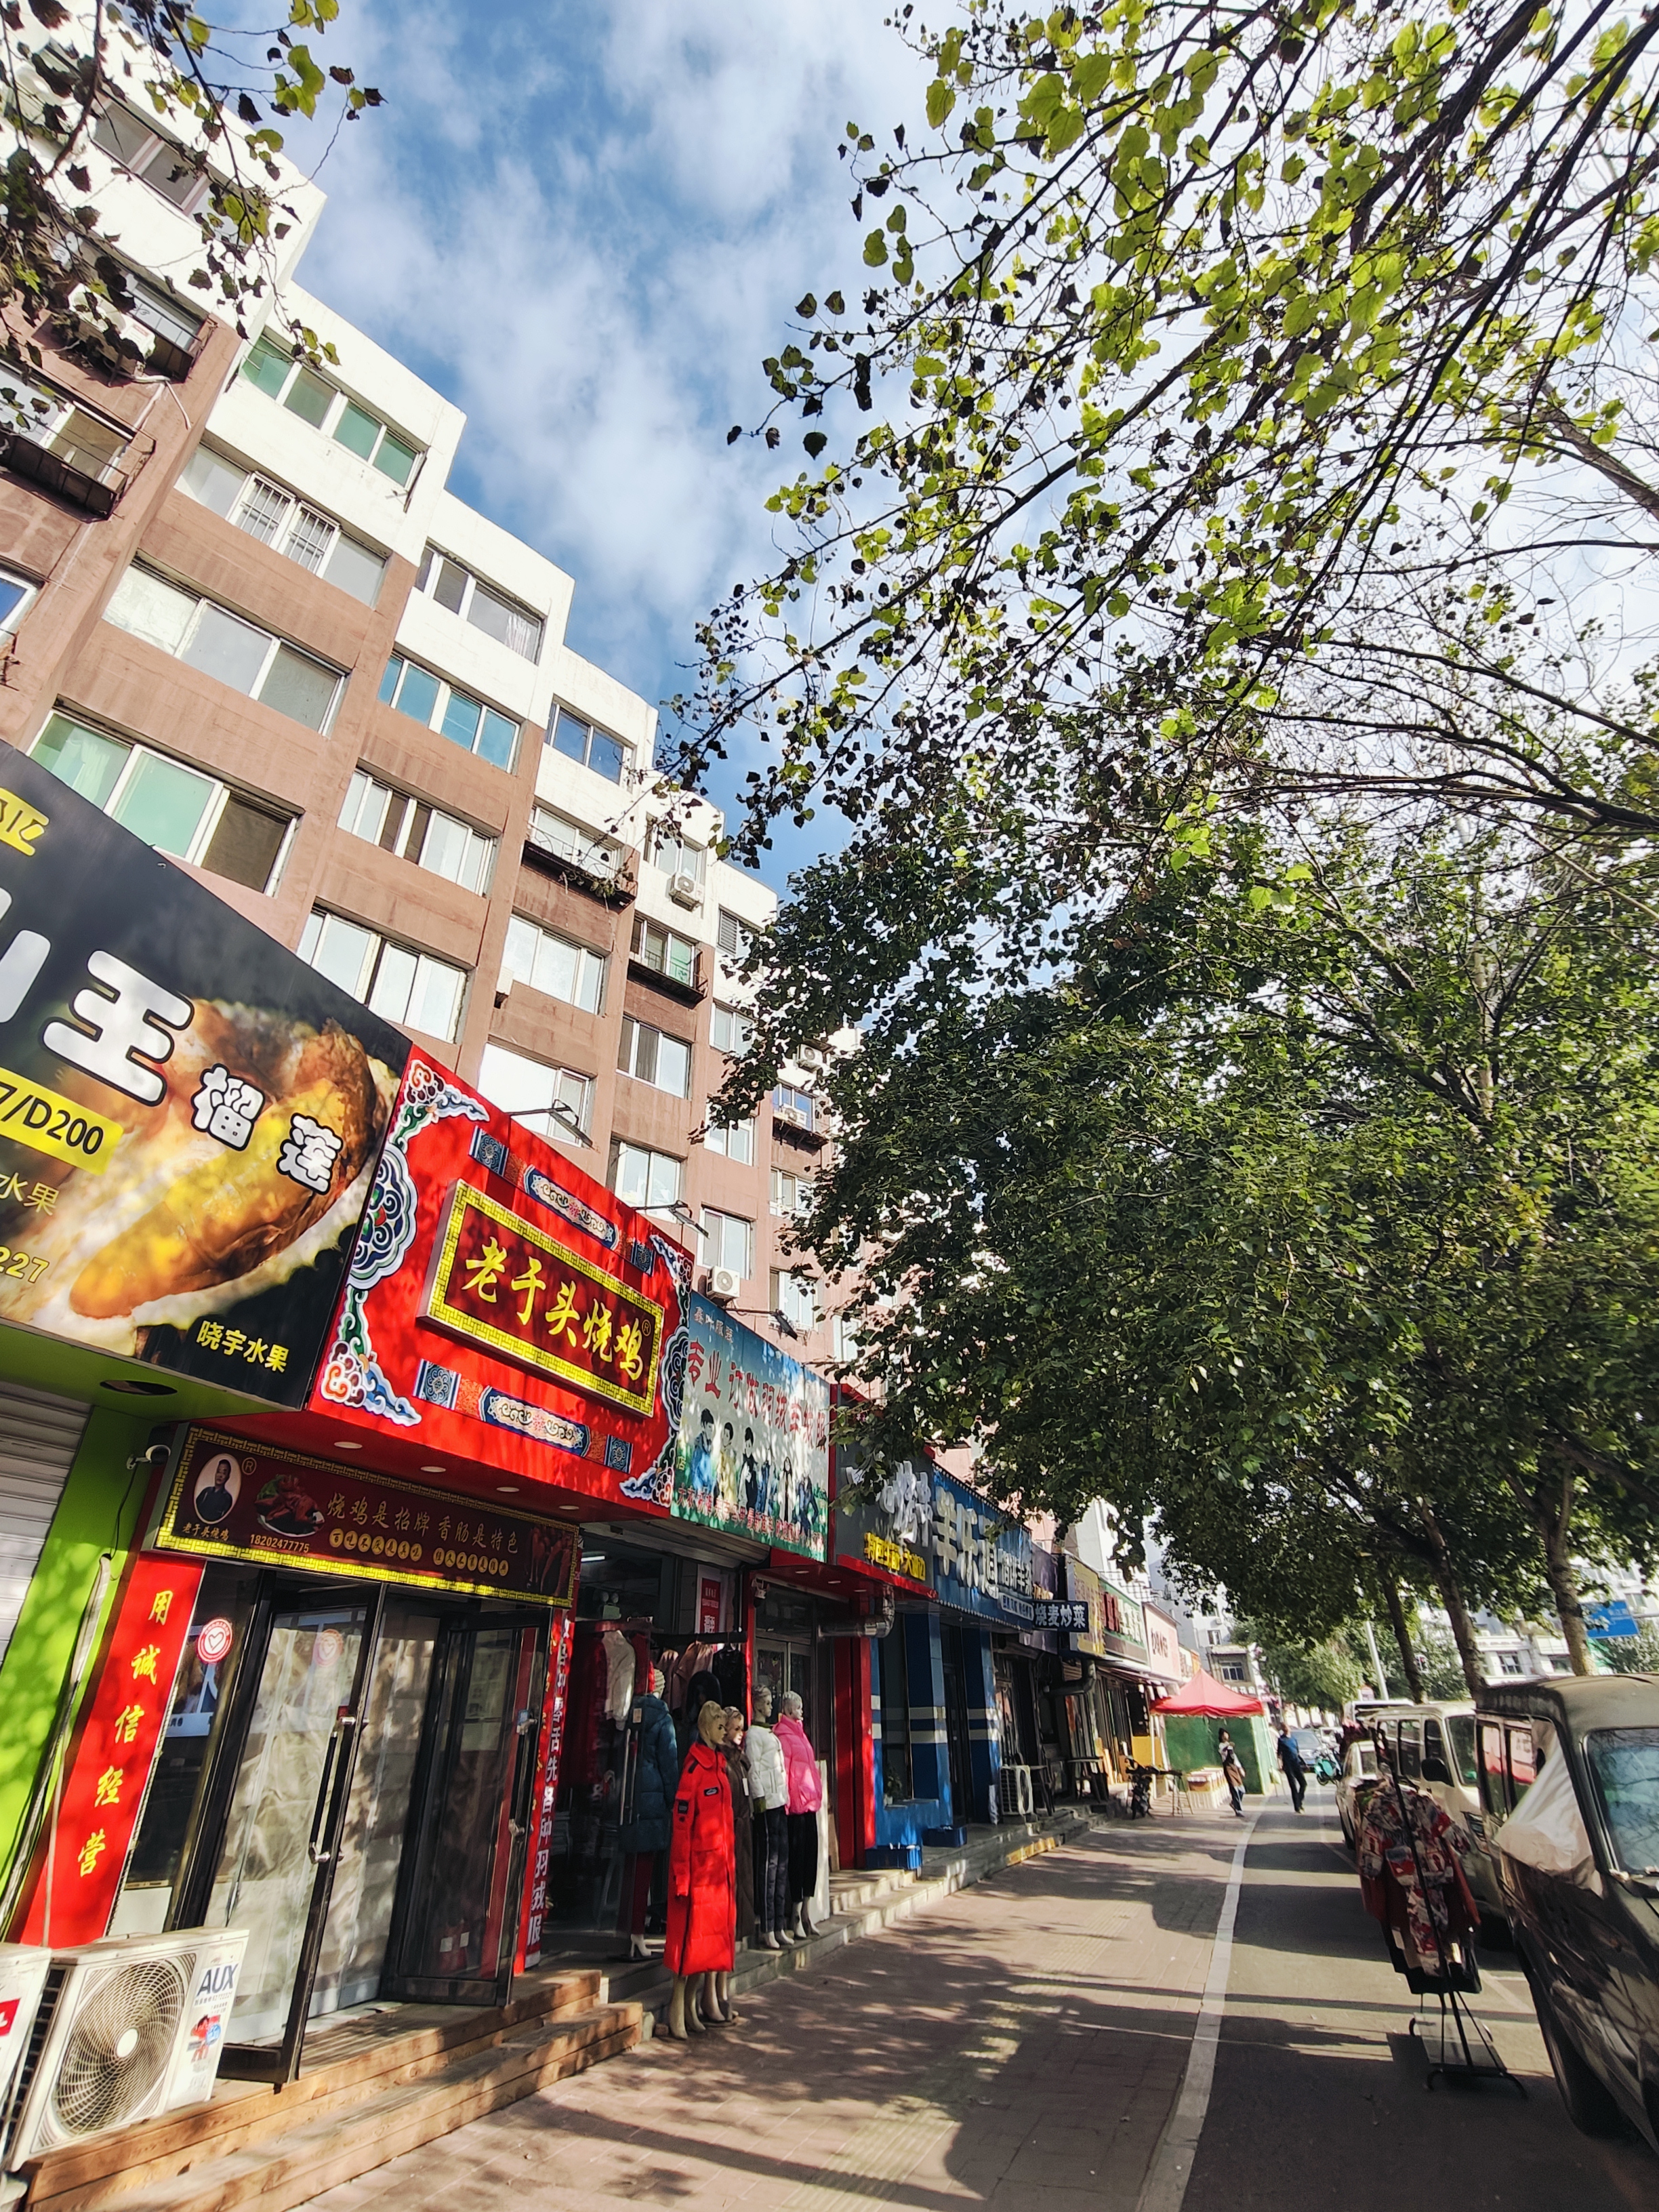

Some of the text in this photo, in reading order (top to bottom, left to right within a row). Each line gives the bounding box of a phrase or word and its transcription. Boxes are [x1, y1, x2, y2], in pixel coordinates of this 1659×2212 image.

[191, 1063, 344, 1195] 榴莲
[197, 1319, 289, 1374] 晓宇水果
[249, 1534, 310, 1553] 18202477775
[327, 1492, 518, 1554] 烧鸡是招牌 香肠是特色
[1035, 1603, 1086, 1628] 烧麦炒菜
[78, 1590, 173, 1878] 用诚信经营
[197, 1963, 239, 1997] AUX
